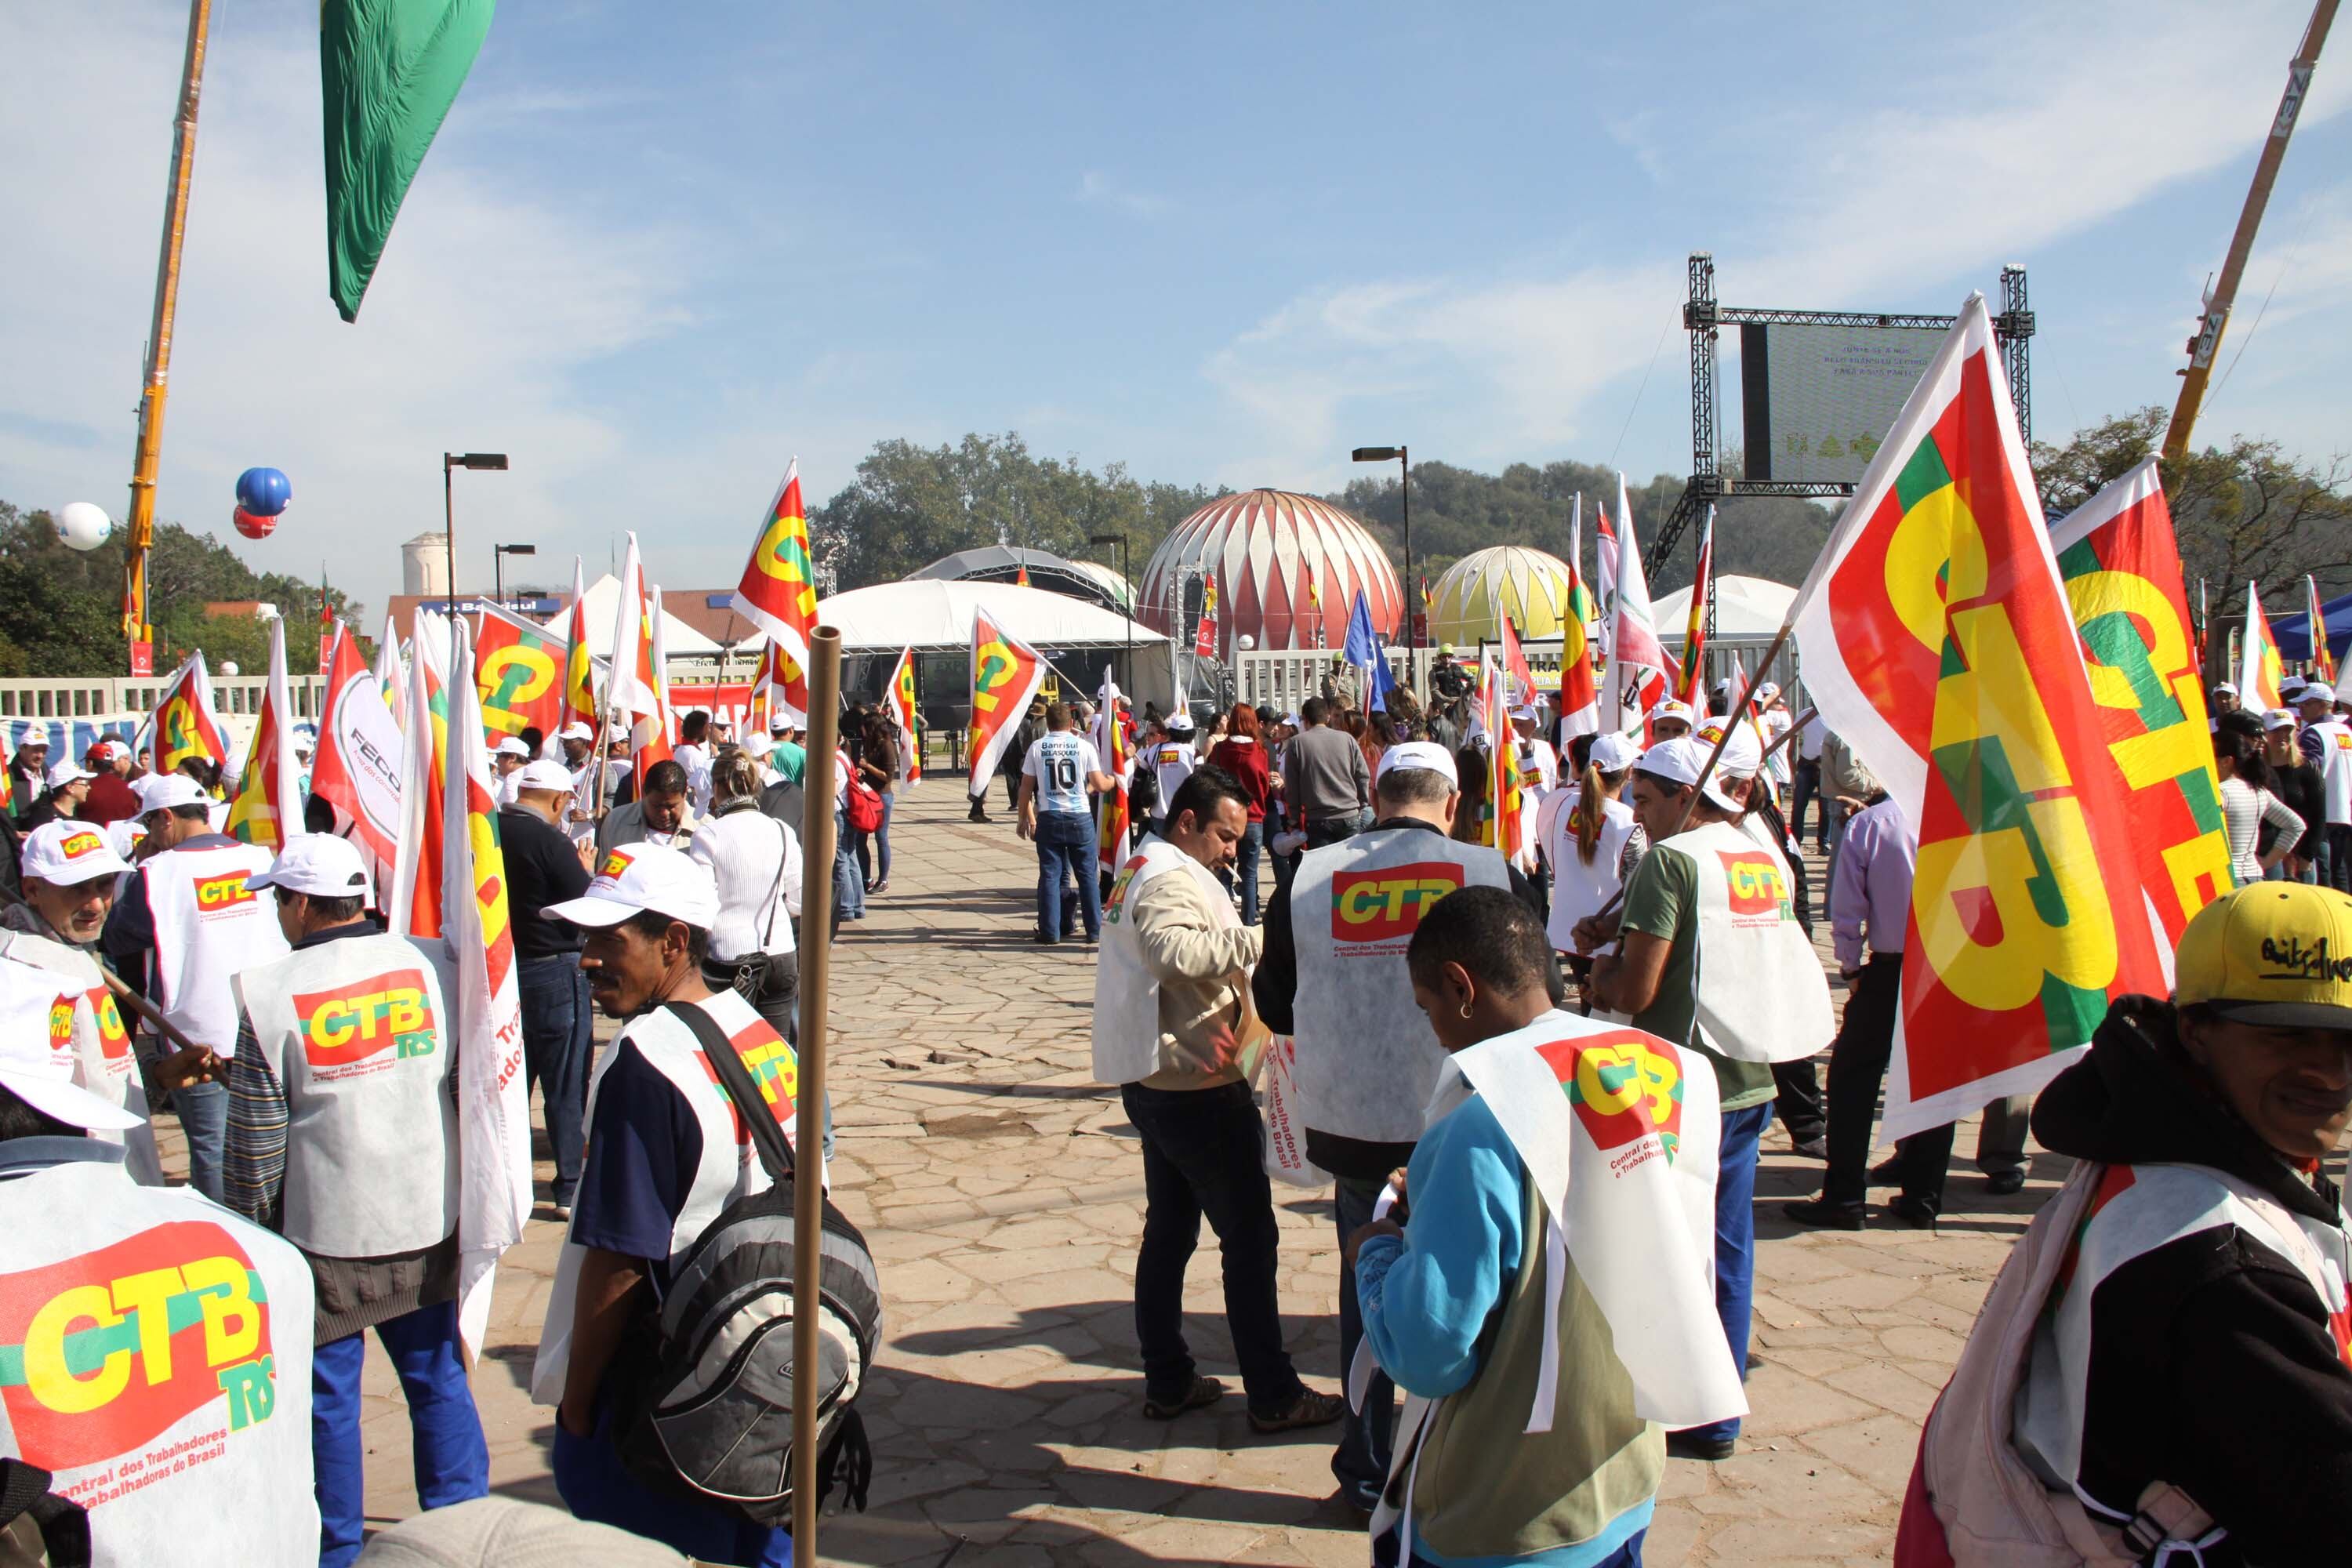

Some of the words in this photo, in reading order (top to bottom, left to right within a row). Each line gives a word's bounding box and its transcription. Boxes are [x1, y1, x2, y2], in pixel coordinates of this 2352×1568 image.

[462, 601, 536, 612] Baisul
[1044, 758, 1076, 790] 10
[64, 834, 101, 854] CTB
[310, 987, 425, 1048] CTB
[312, 1068, 338, 1077] Central
[1272, 1131, 1292, 1169] Brasil
[1610, 1145, 1640, 1170] Central
[1642, 1139, 1661, 1150] dos
[24, 1256, 261, 1414] CTB
[57, 1467, 114, 1498] entral
[118, 1461, 144, 1479] dos
[145, 1428, 227, 1467] Trabalhadores
[74, 1468, 171, 1510] rabalhadoras
[172, 1458, 186, 1474] do
[187, 1442, 226, 1468] Brasil
